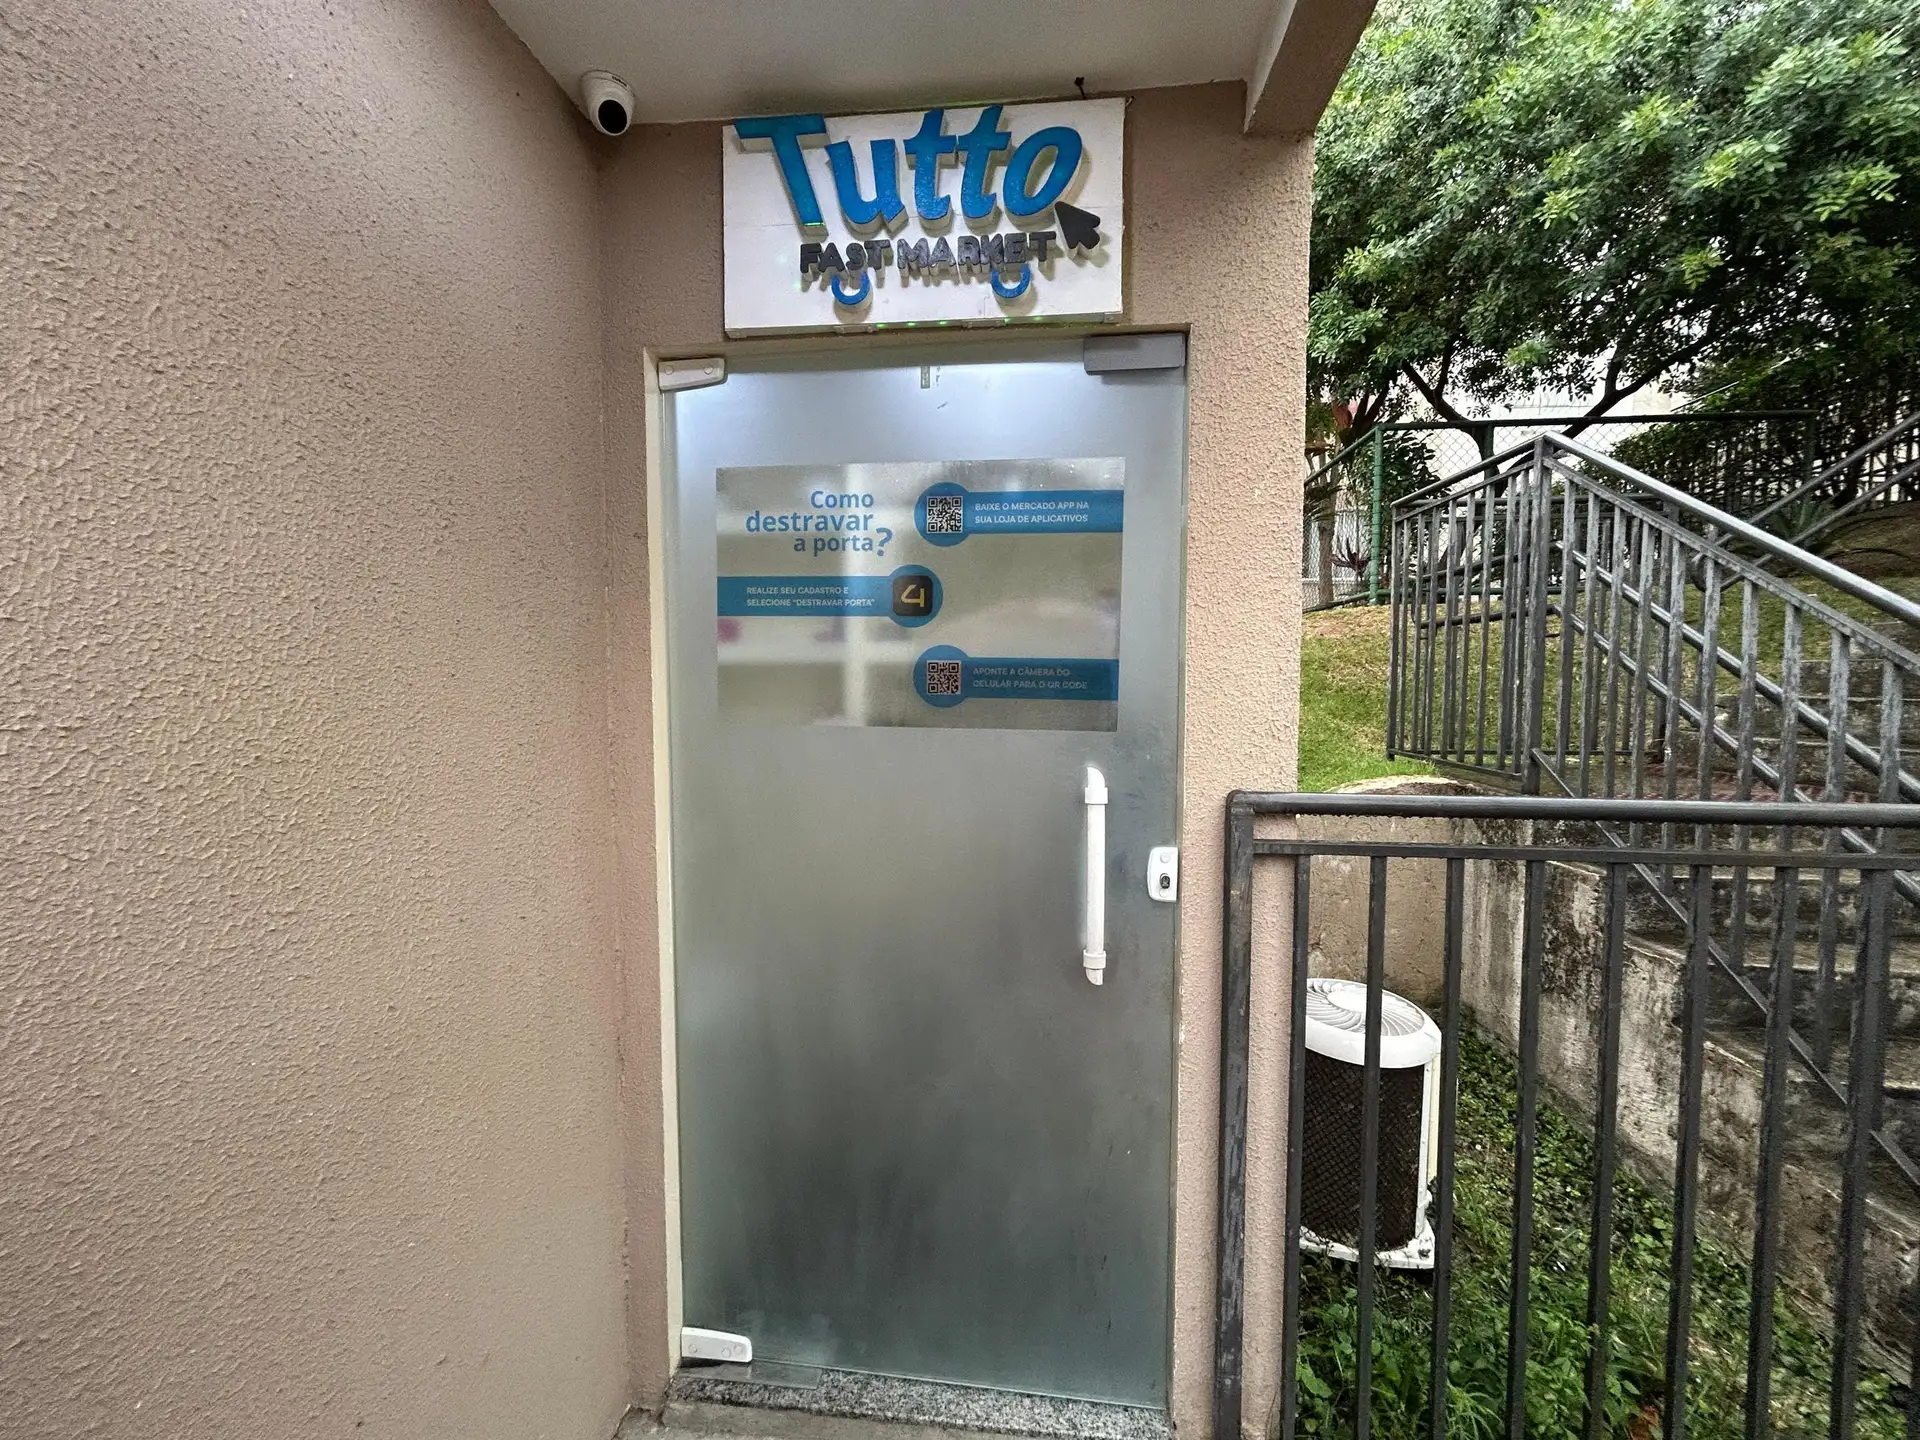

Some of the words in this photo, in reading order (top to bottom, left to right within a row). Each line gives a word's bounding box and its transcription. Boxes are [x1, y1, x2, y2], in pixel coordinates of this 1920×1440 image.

[733, 104, 1083, 226] Tutto
[800, 240, 890, 273] FAST
[897, 231, 1057, 270] MARKET
[810, 490, 875, 509] Como
[975, 502, 1000, 511] BAIXE
[1002, 502, 1009, 511] O
[1011, 502, 1056, 511] MERCADO
[1058, 502, 1075, 510] APP
[1076, 501, 1089, 509] NA
[745, 511, 874, 533] destravar
[975, 516, 992, 524] SUA
[994, 515, 1015, 524] LOJA
[1018, 515, 1030, 523] DE
[1031, 514, 1088, 523] APLICATIVOS
[793, 538, 806, 552] a
[746, 587, 779, 595] REALIZE
[780, 587, 797, 595] SEU
[798, 587, 842, 595] CADASTRO
[746, 599, 791, 607] SELECIONE
[973, 667, 1009, 676] APONTE
[1017, 666, 1054, 677] CÂMERA
[1056, 669, 1070, 677] DO
[973, 680, 1012, 688] CELULAR
[1013, 680, 1037, 688] PARA
[1039, 680, 1046, 688] O
[1062, 680, 1088, 689] CODE
